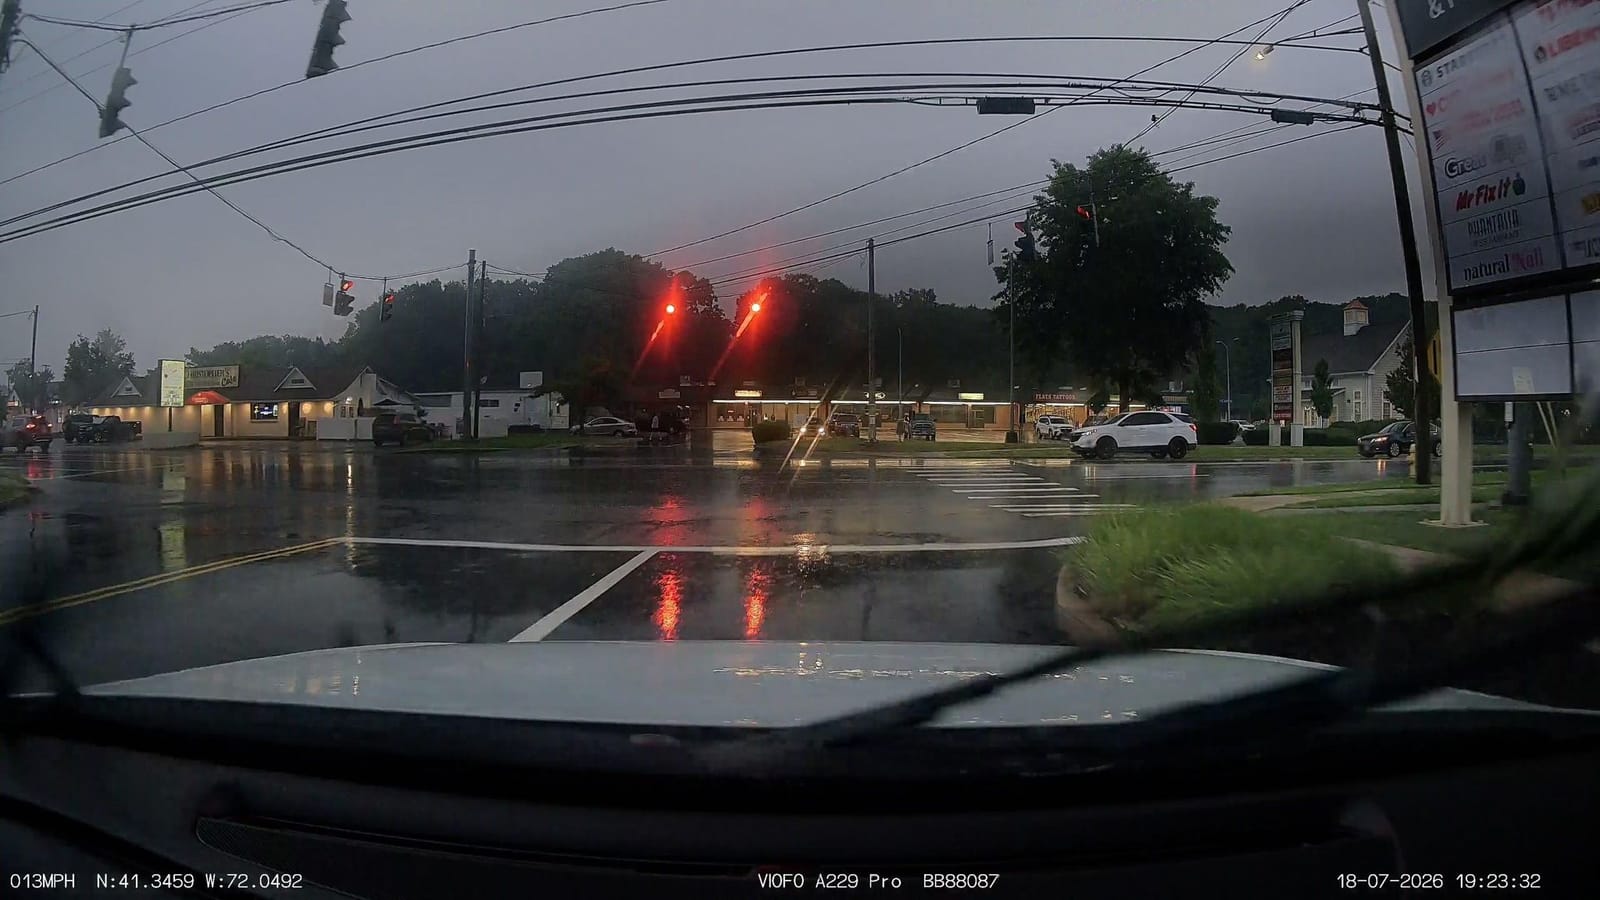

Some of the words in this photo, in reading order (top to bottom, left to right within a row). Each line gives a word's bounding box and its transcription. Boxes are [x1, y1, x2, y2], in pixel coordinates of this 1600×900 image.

[1457, 190, 1475, 211] Mr
[1475, 184, 1496, 205] Fix
[1498, 177, 1511, 199] It
[1464, 254, 1510, 281] natural
